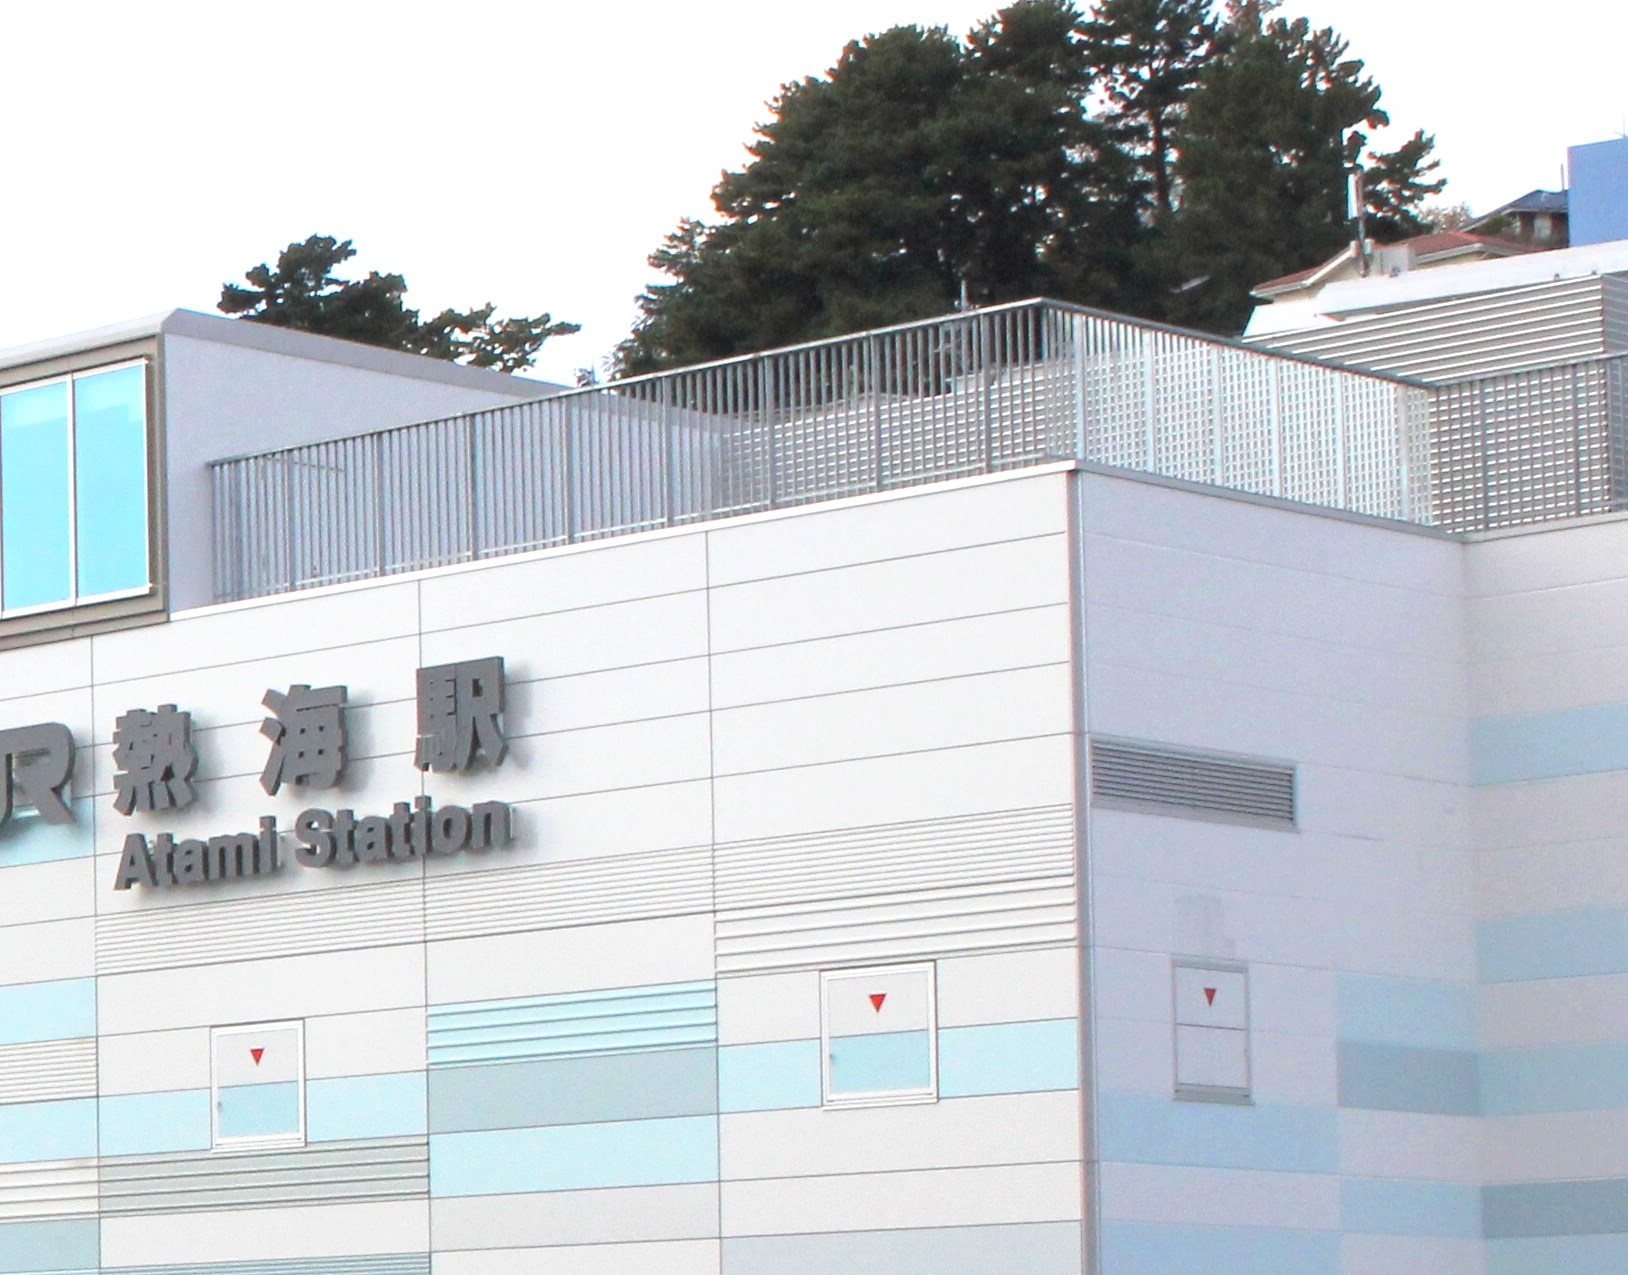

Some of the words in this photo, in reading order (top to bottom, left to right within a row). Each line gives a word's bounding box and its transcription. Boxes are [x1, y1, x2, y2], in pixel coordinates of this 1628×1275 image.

[113, 656, 509, 815] 熱海駅
[114, 815, 282, 890] Atami
[295, 795, 513, 868] Station
